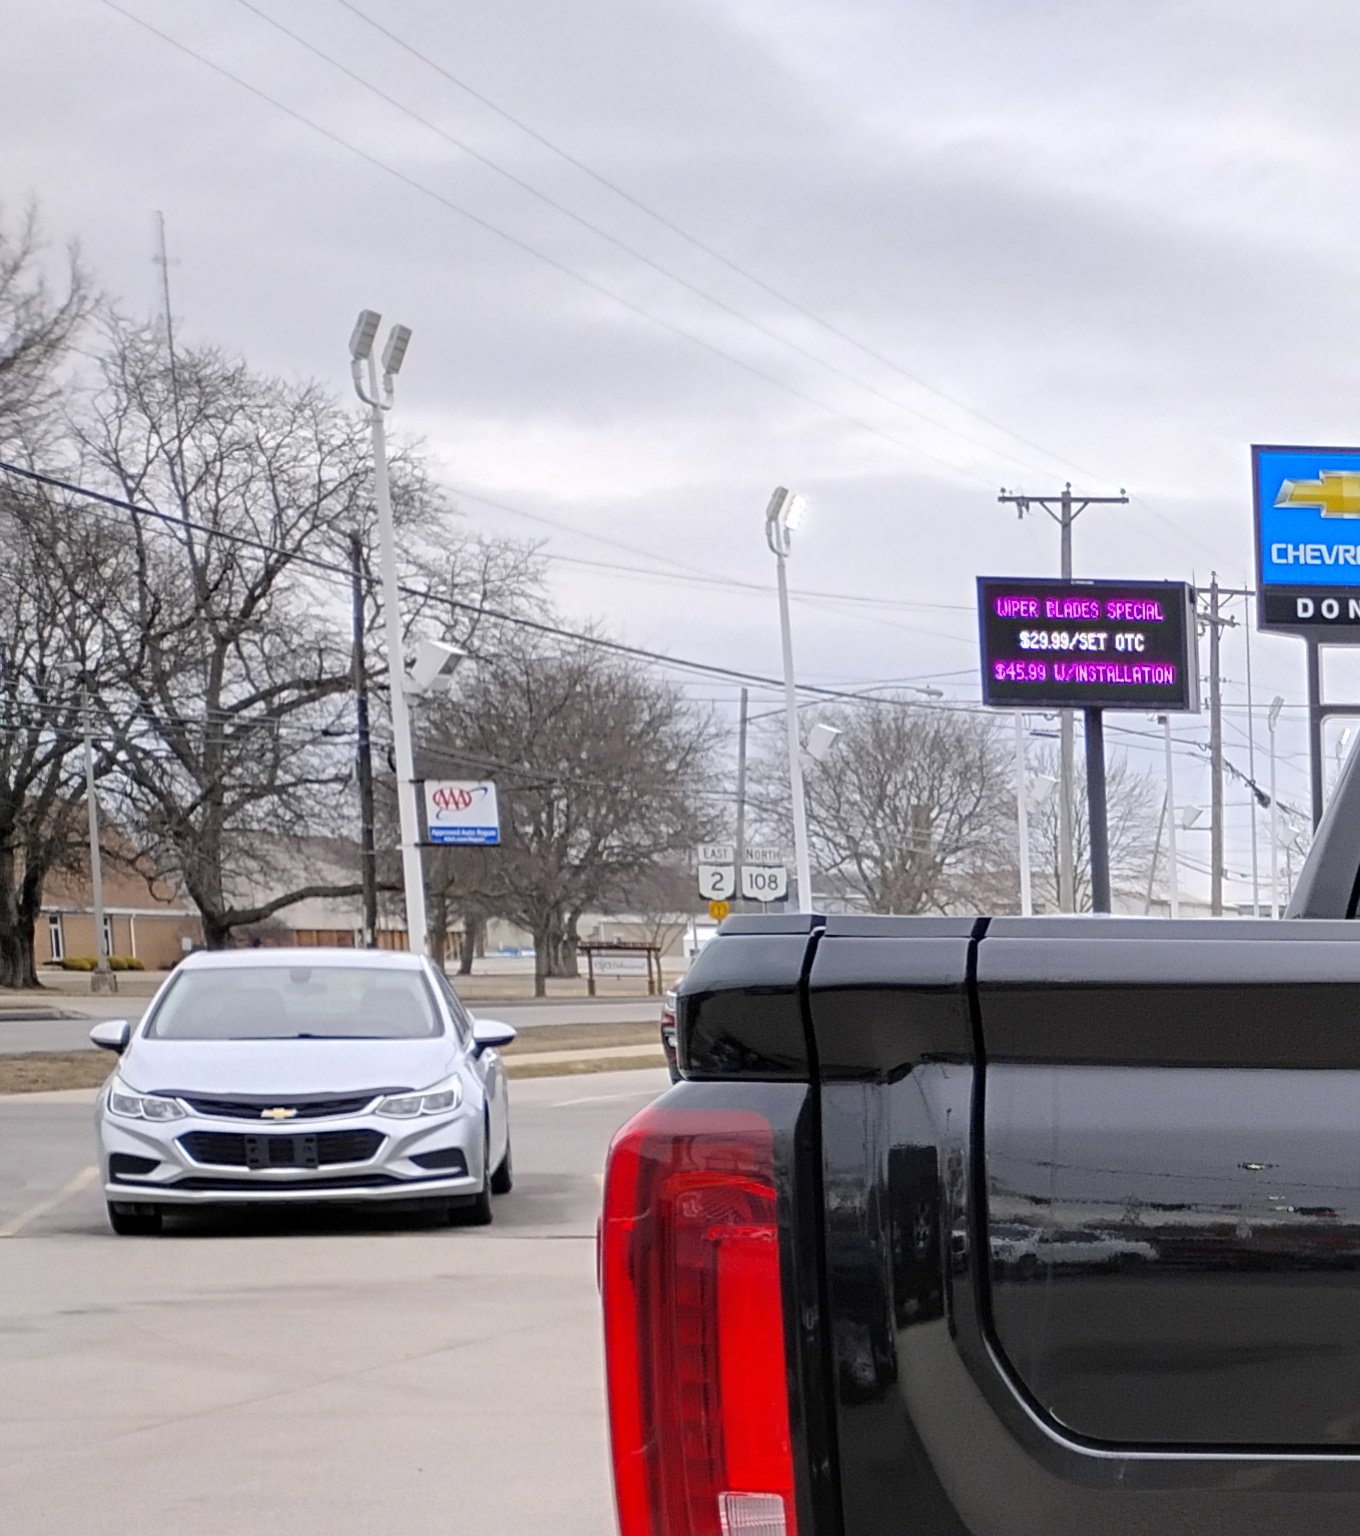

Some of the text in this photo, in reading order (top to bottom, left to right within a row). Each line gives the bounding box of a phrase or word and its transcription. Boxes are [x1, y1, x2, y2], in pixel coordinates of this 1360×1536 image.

[996, 597, 1165, 621] WIPER BLADES SPECIAL
[1018, 630, 1145, 652] $29.99/SET OTC
[994, 662, 1174, 684] $45.99 W/INSTALLATION
[434, 787, 471, 811] AAA
[703, 847, 727, 859] EAST
[746, 848, 780, 860] NORTH
[711, 872, 724, 891] 2
[749, 873, 778, 891] 108
